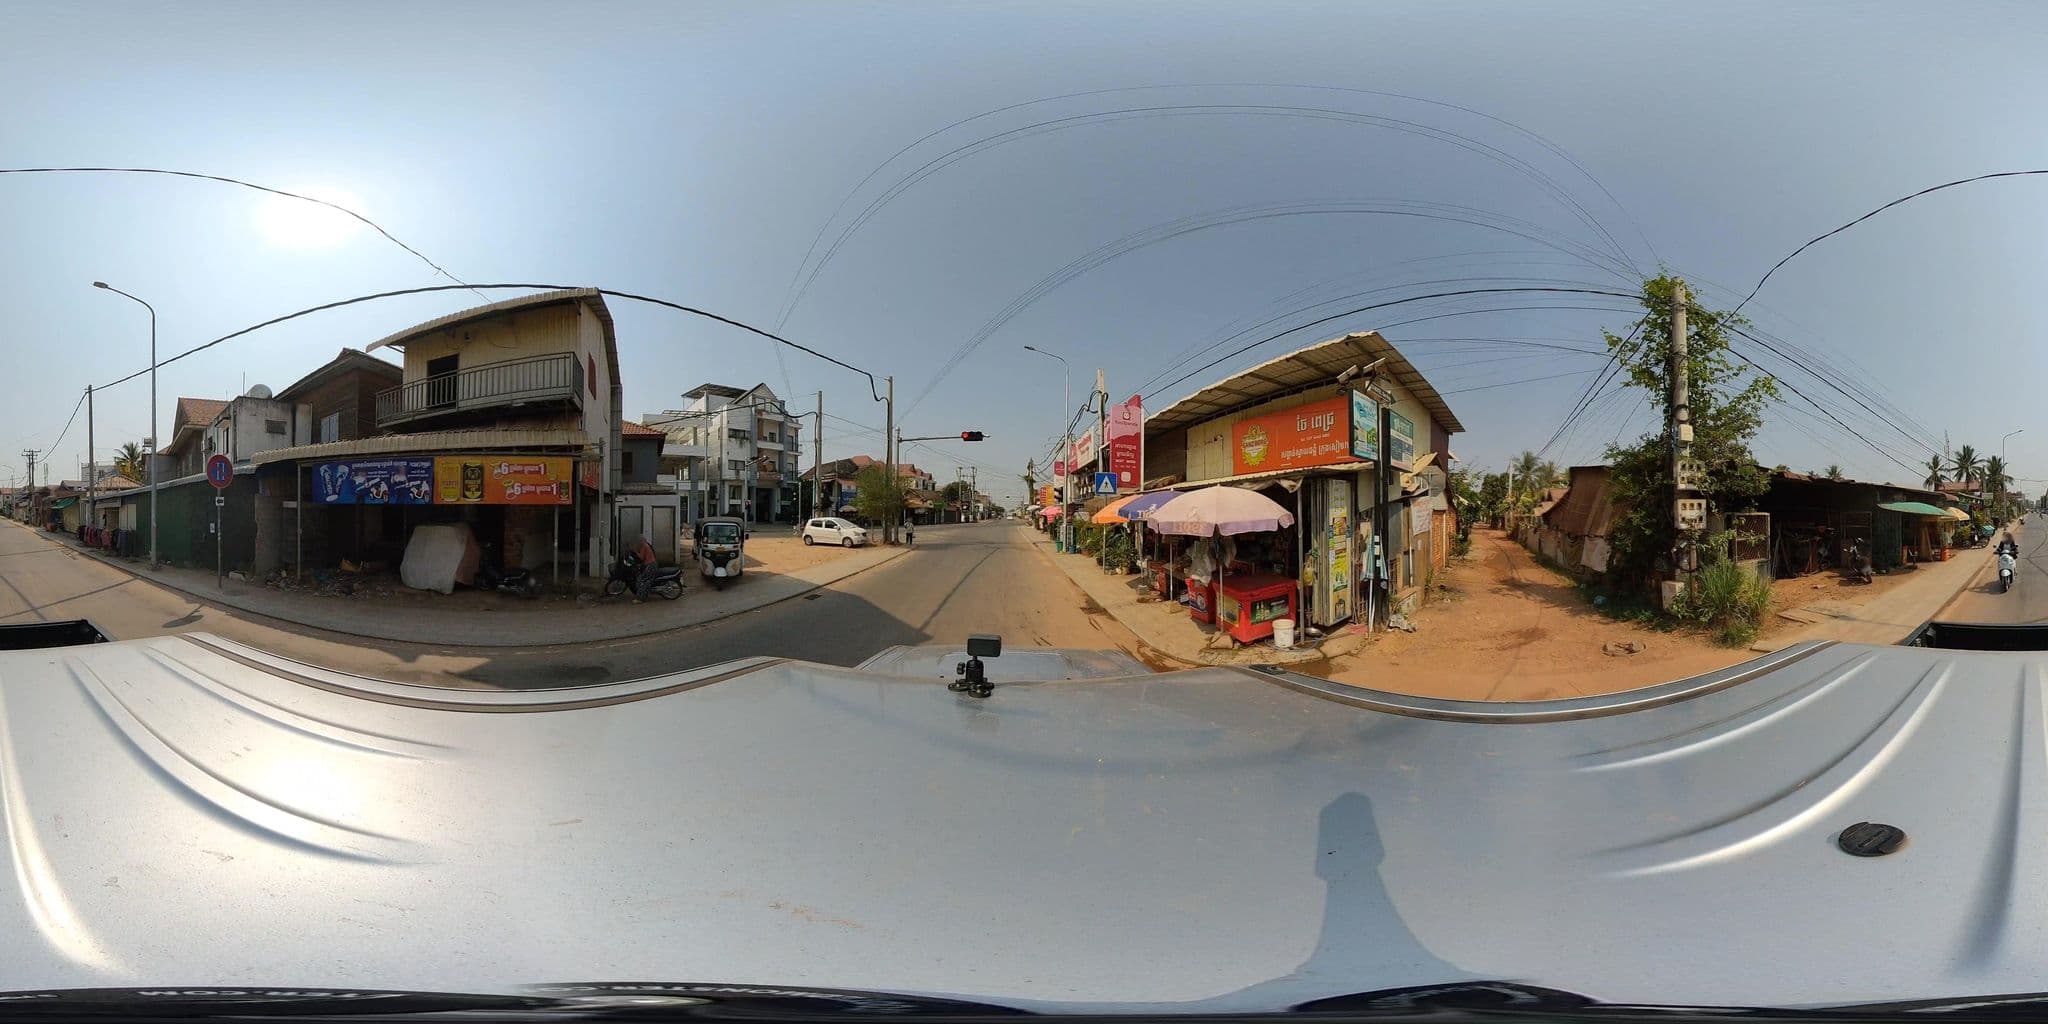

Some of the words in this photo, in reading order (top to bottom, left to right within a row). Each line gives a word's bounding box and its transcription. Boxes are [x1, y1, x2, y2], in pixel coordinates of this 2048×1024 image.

[501, 462, 509, 474] 6
[538, 463, 545, 475] 1
[514, 482, 522, 495] 6
[551, 482, 557, 495] 1
